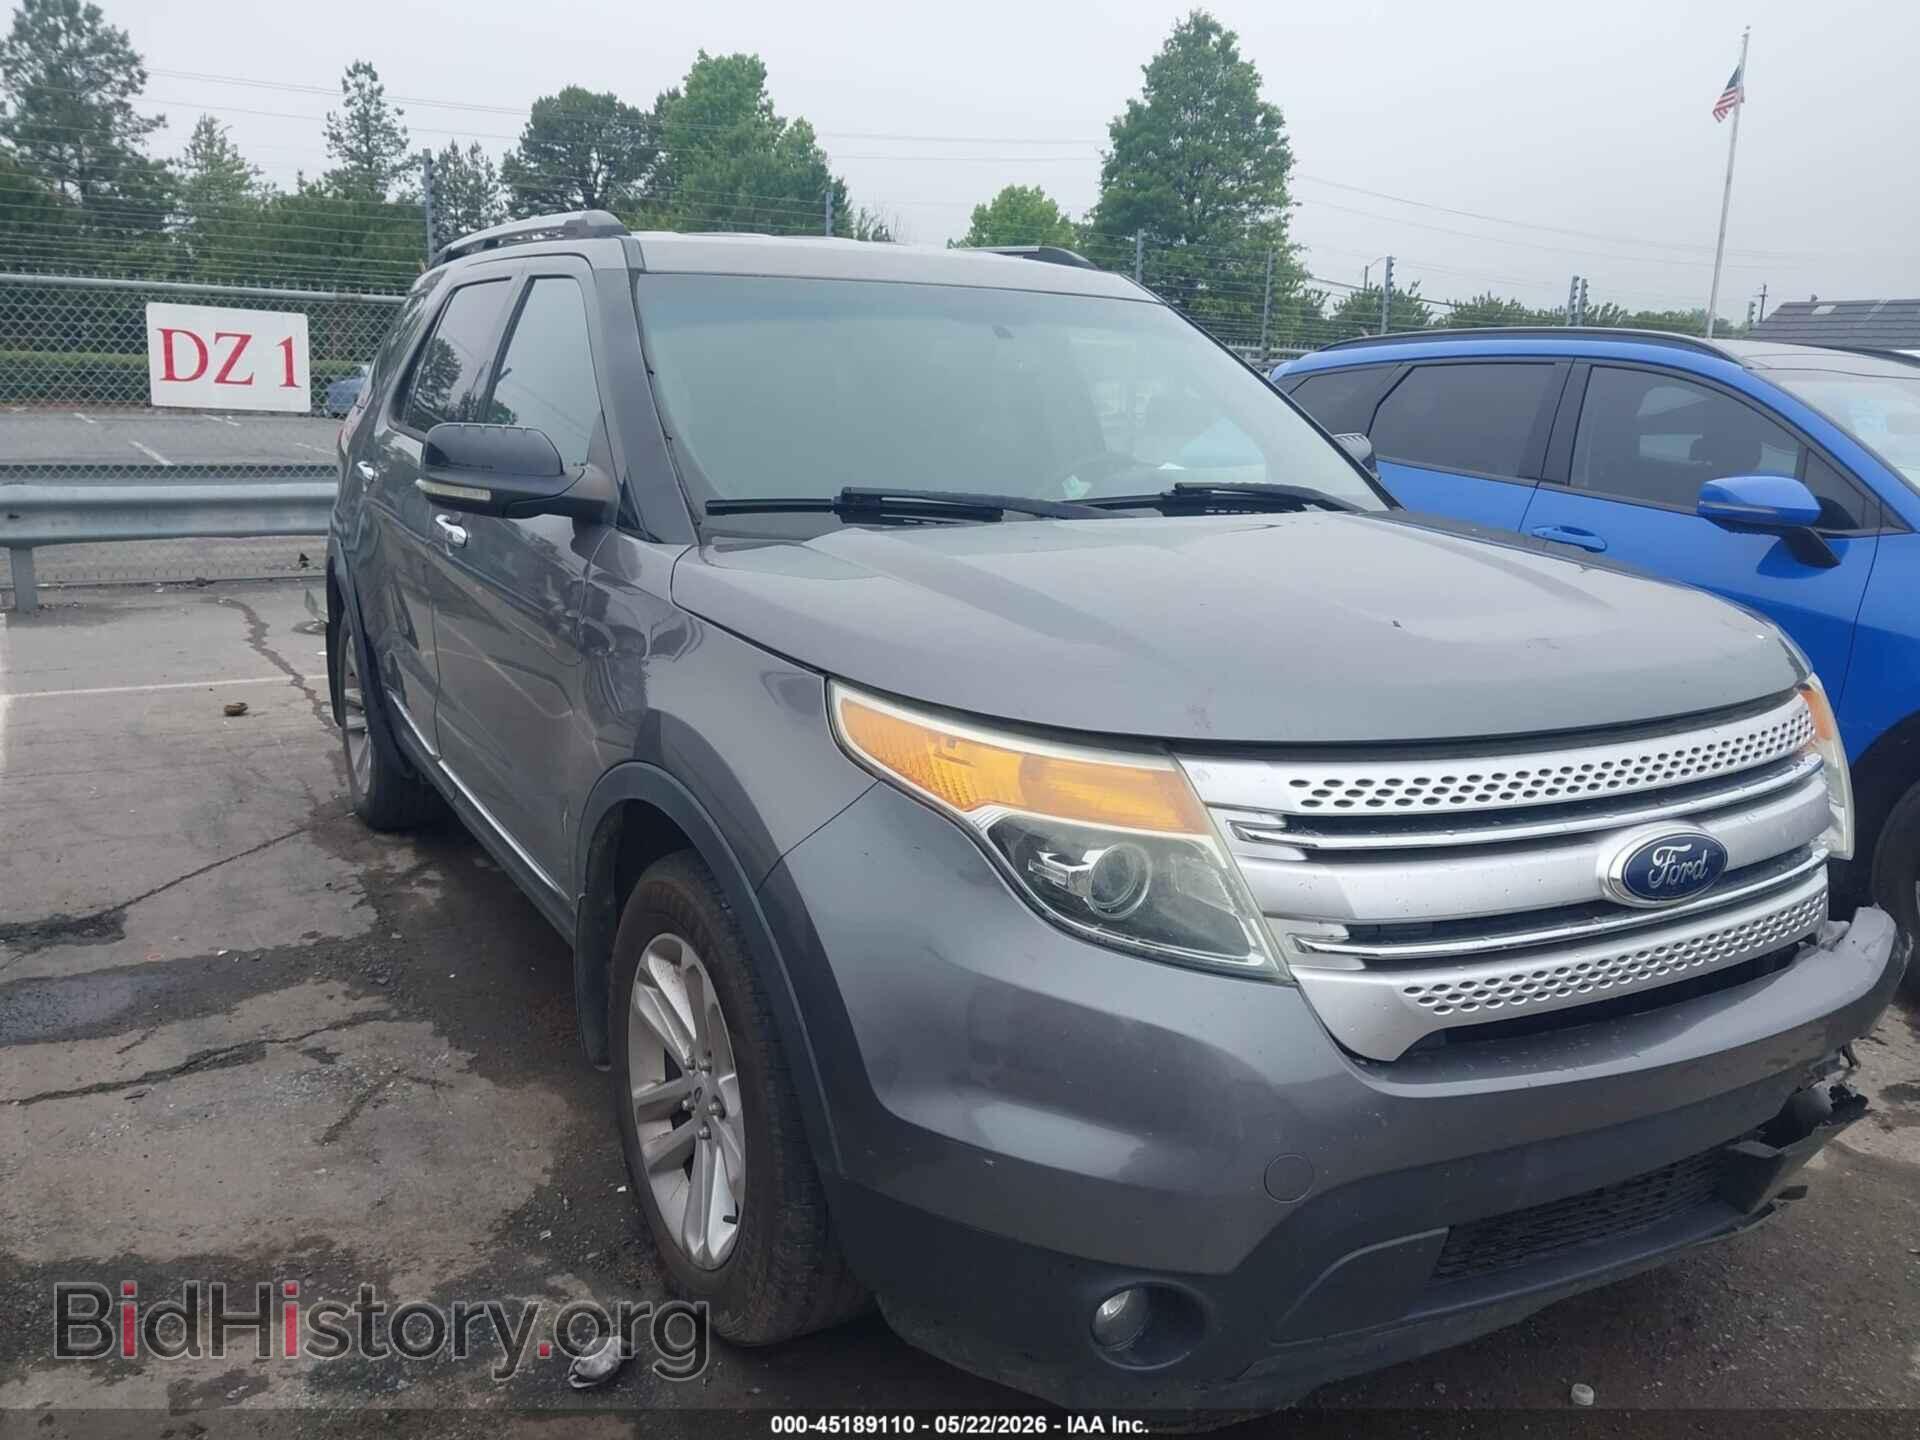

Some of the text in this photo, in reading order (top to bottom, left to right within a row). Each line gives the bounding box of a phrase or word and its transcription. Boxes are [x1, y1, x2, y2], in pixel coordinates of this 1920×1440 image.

[157, 328, 302, 388] DZ 1
[1648, 843, 1708, 888] Ford
